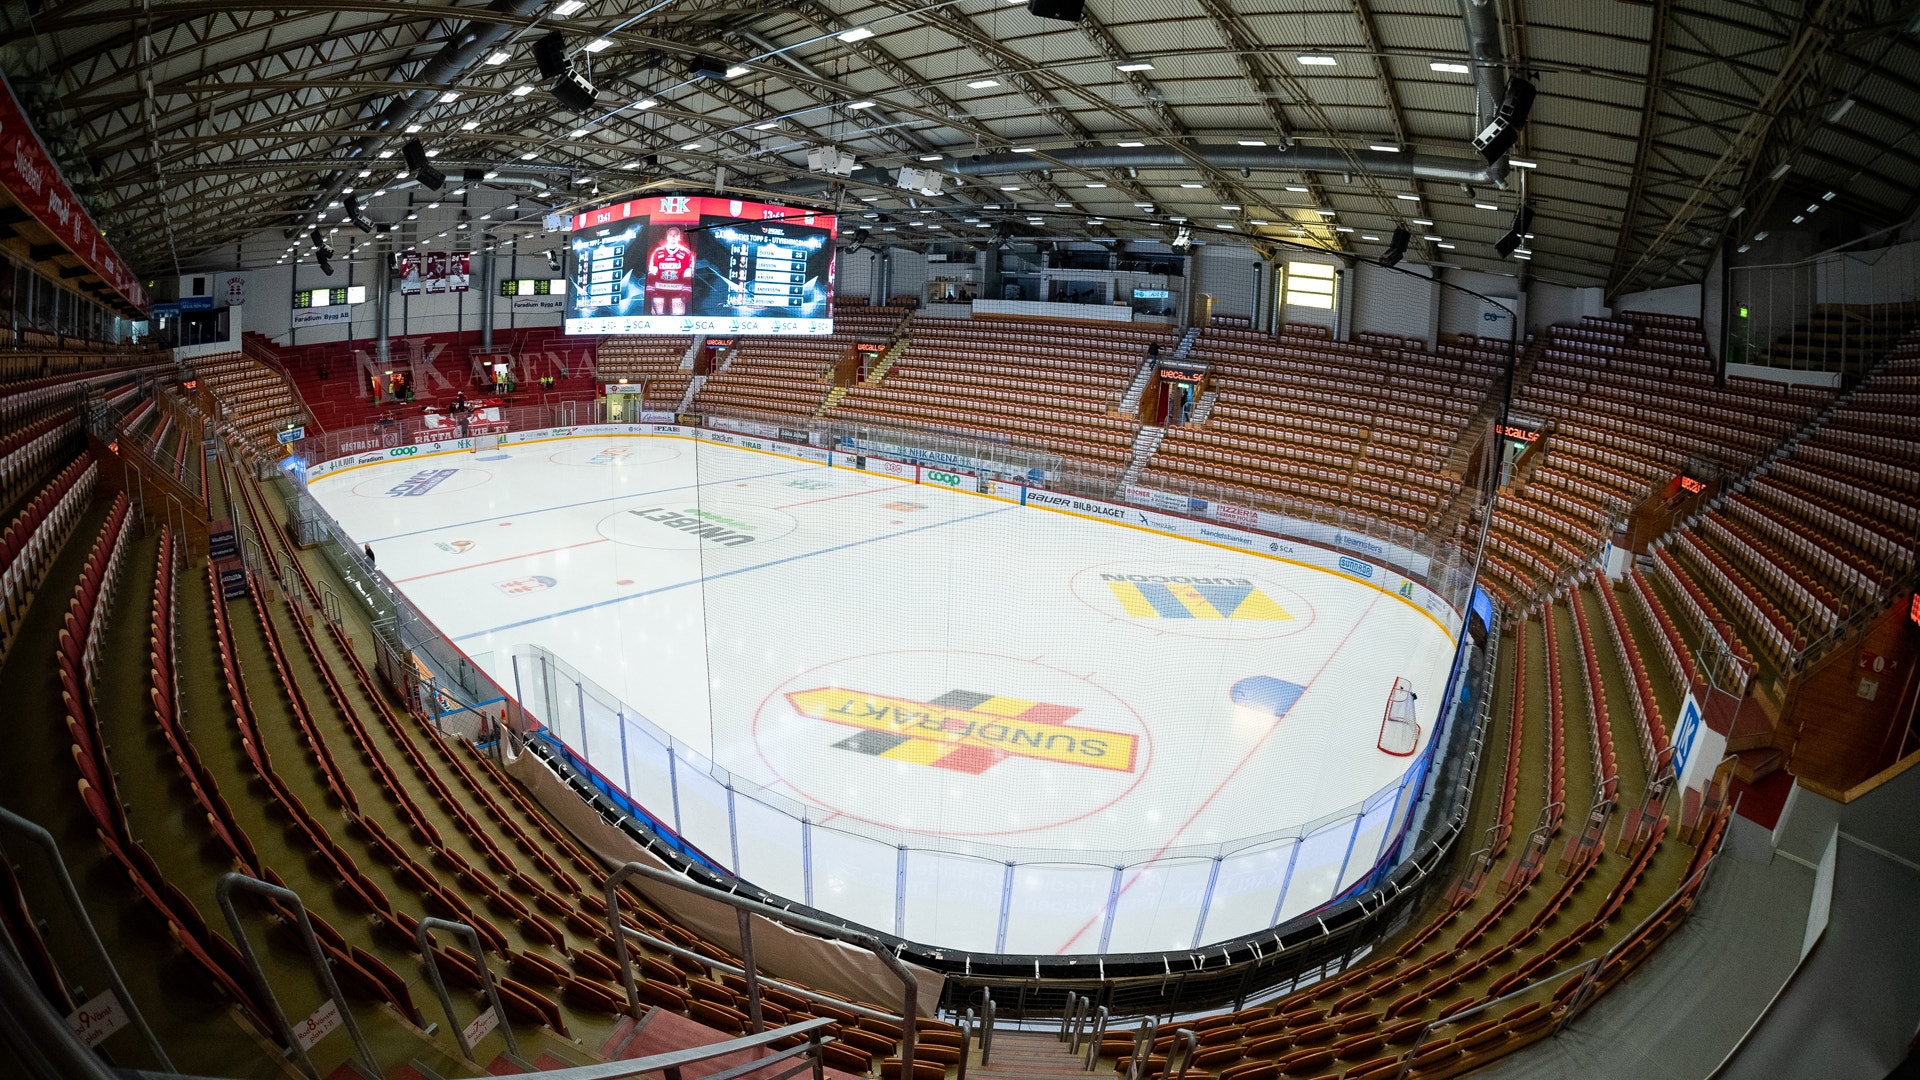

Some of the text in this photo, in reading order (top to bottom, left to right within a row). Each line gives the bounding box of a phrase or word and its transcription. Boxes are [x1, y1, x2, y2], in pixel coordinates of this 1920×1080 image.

[659, 196, 691, 215] NHK
[294, 315, 322, 323] Faradium
[324, 313, 339, 321] Bygg
[633, 320, 651, 329] SCA
[695, 320, 715, 330] SCA
[741, 321, 759, 330] SCA
[782, 322, 798, 331] SCA
[467, 349, 597, 387] ARENA
[414, 425, 509, 444] RÄTTA VIRET
[711, 432, 734, 444] stadium
[341, 437, 380, 453] VÄSTRA STÅ
[390, 445, 418, 457] coop
[741, 440, 762, 450] TIRAB
[358, 456, 384, 466] Faradium
[909, 447, 928, 458] NHK
[930, 450, 958, 464] ARENA
[927, 470, 961, 487] coop
[1073, 501, 1125, 519] BILBOLAGET
[627, 508, 756, 547] UNIBET
[1200, 527, 1253, 546] Handelsbanken
[1279, 544, 1294, 555] SCA
[1343, 536, 1384, 554] teamsters
[1100, 573, 1254, 588] EUROCON
[828, 699, 1108, 758] SUNDFRAKT
